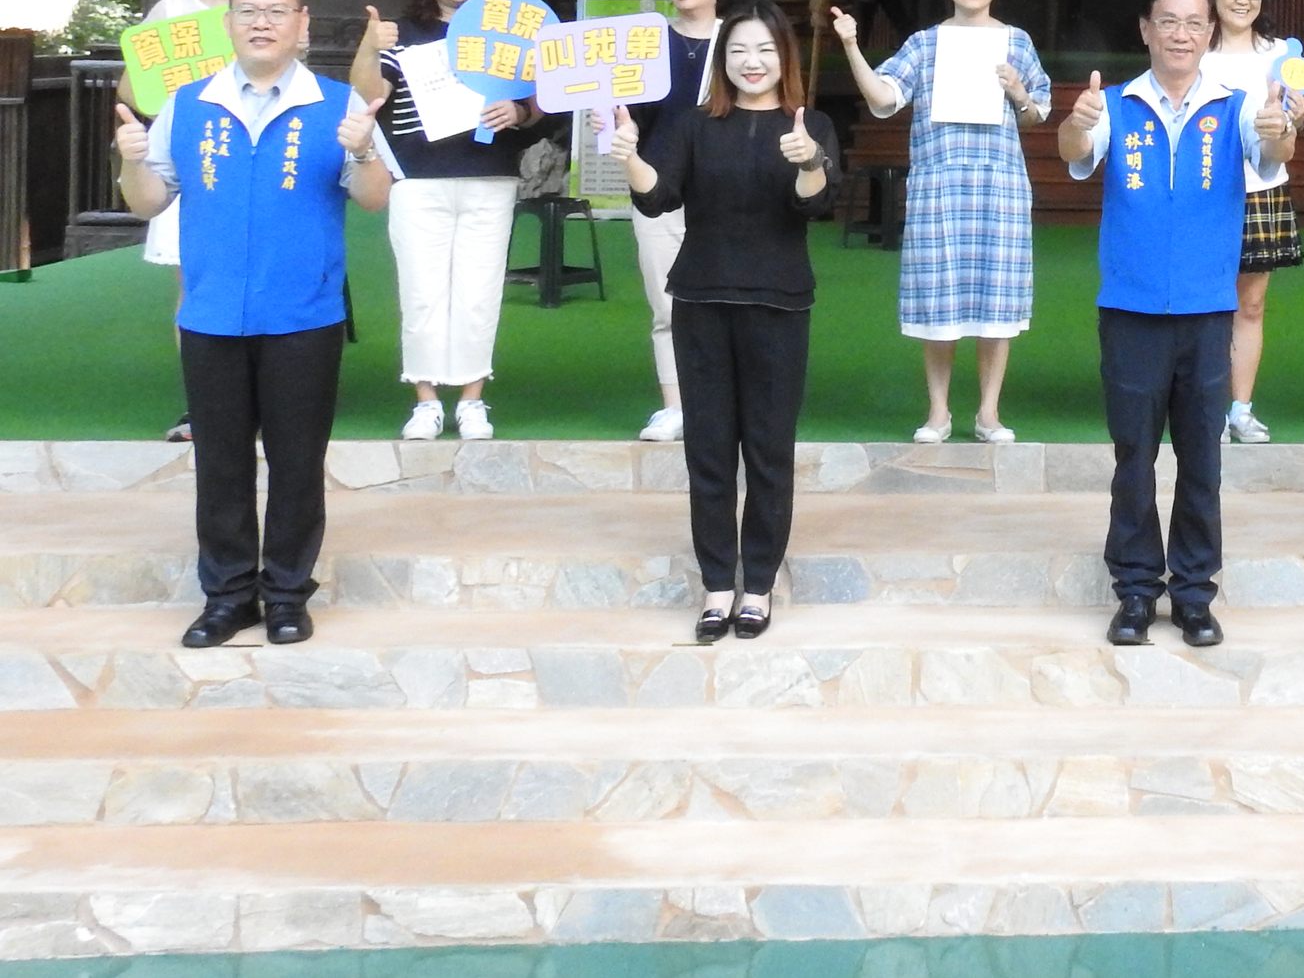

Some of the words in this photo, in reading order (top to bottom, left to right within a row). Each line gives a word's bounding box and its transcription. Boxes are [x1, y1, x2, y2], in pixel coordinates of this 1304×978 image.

[130, 19, 203, 71] 資深
[540, 26, 663, 73] 叫我第
[564, 63, 645, 99] 一名
